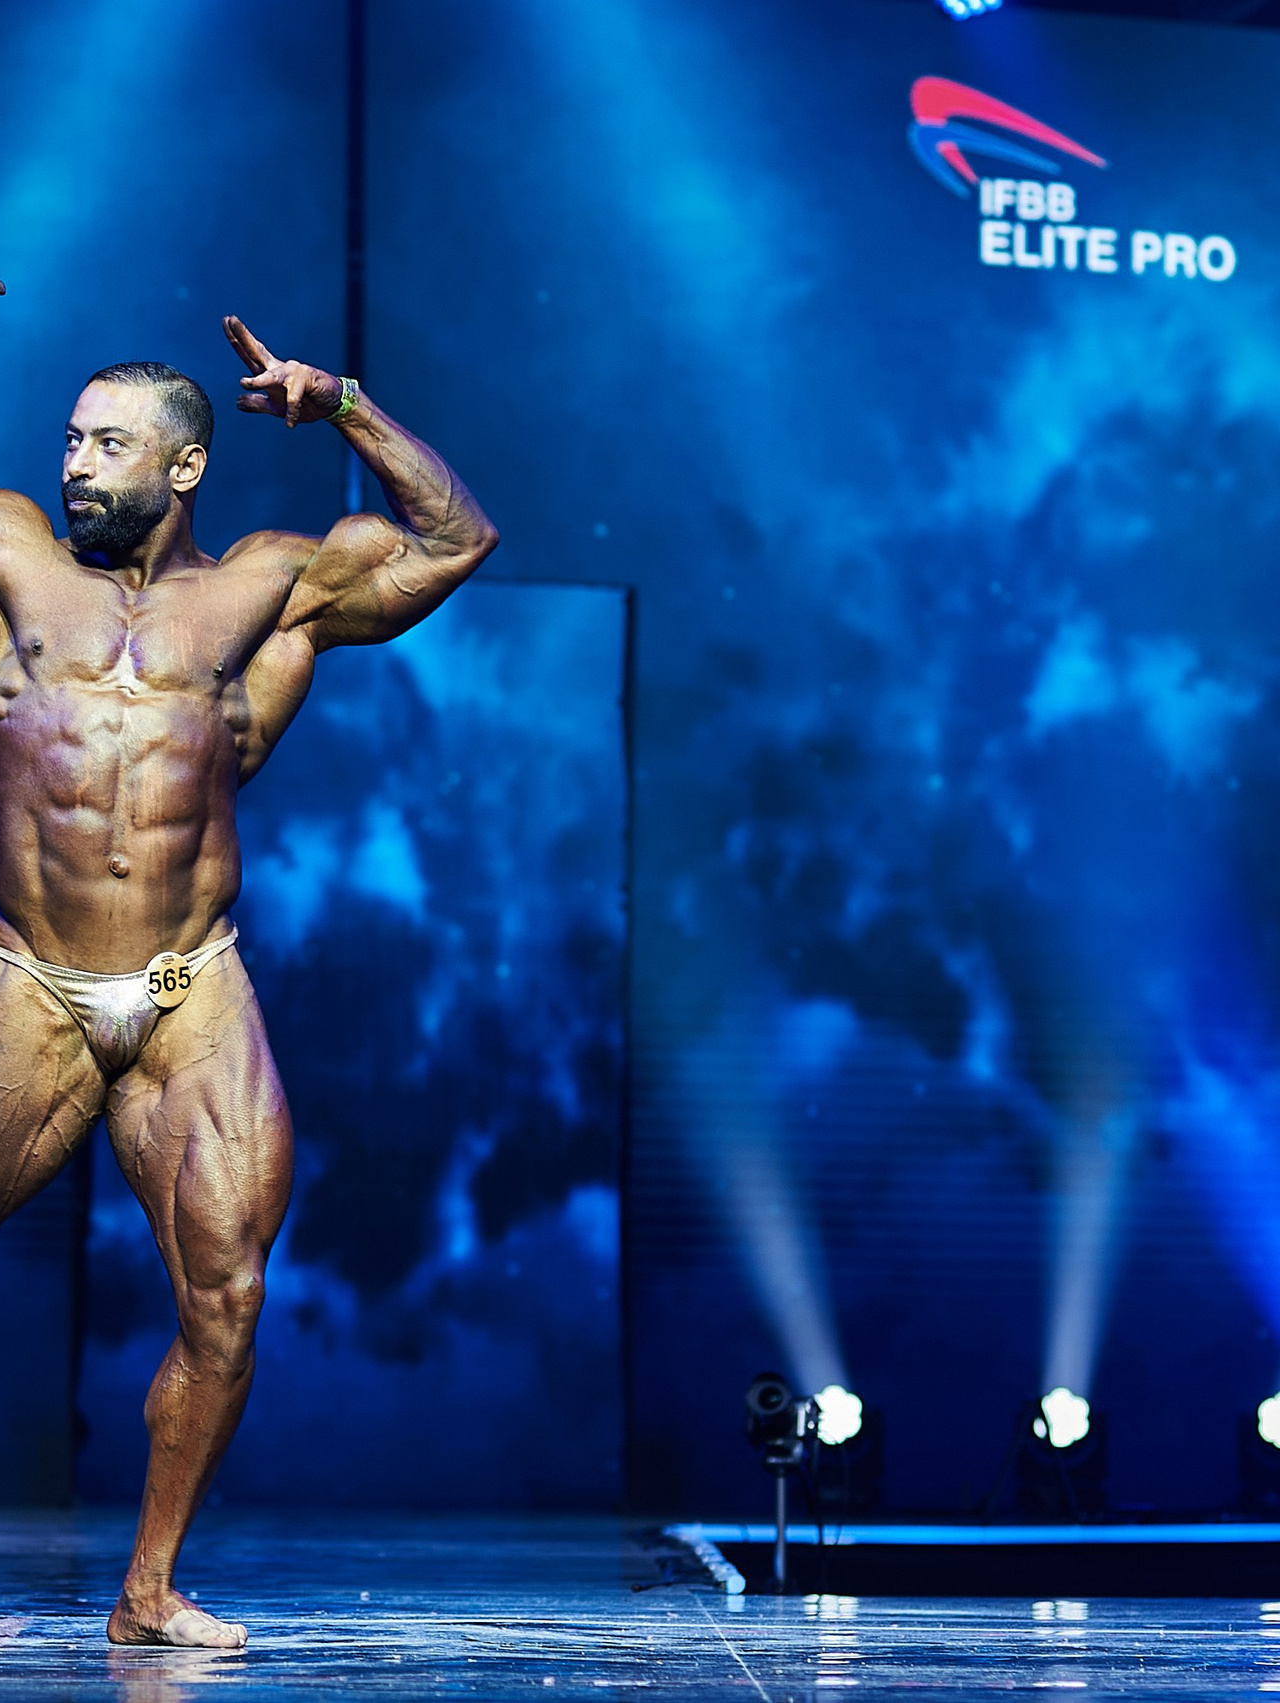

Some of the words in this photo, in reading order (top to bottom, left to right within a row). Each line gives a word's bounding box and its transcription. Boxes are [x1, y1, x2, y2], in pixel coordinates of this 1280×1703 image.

[980, 177, 1076, 222] IFBB
[980, 220, 1118, 273] ELITE
[1131, 230, 1236, 281] PRO
[148, 965, 191, 995] 565
